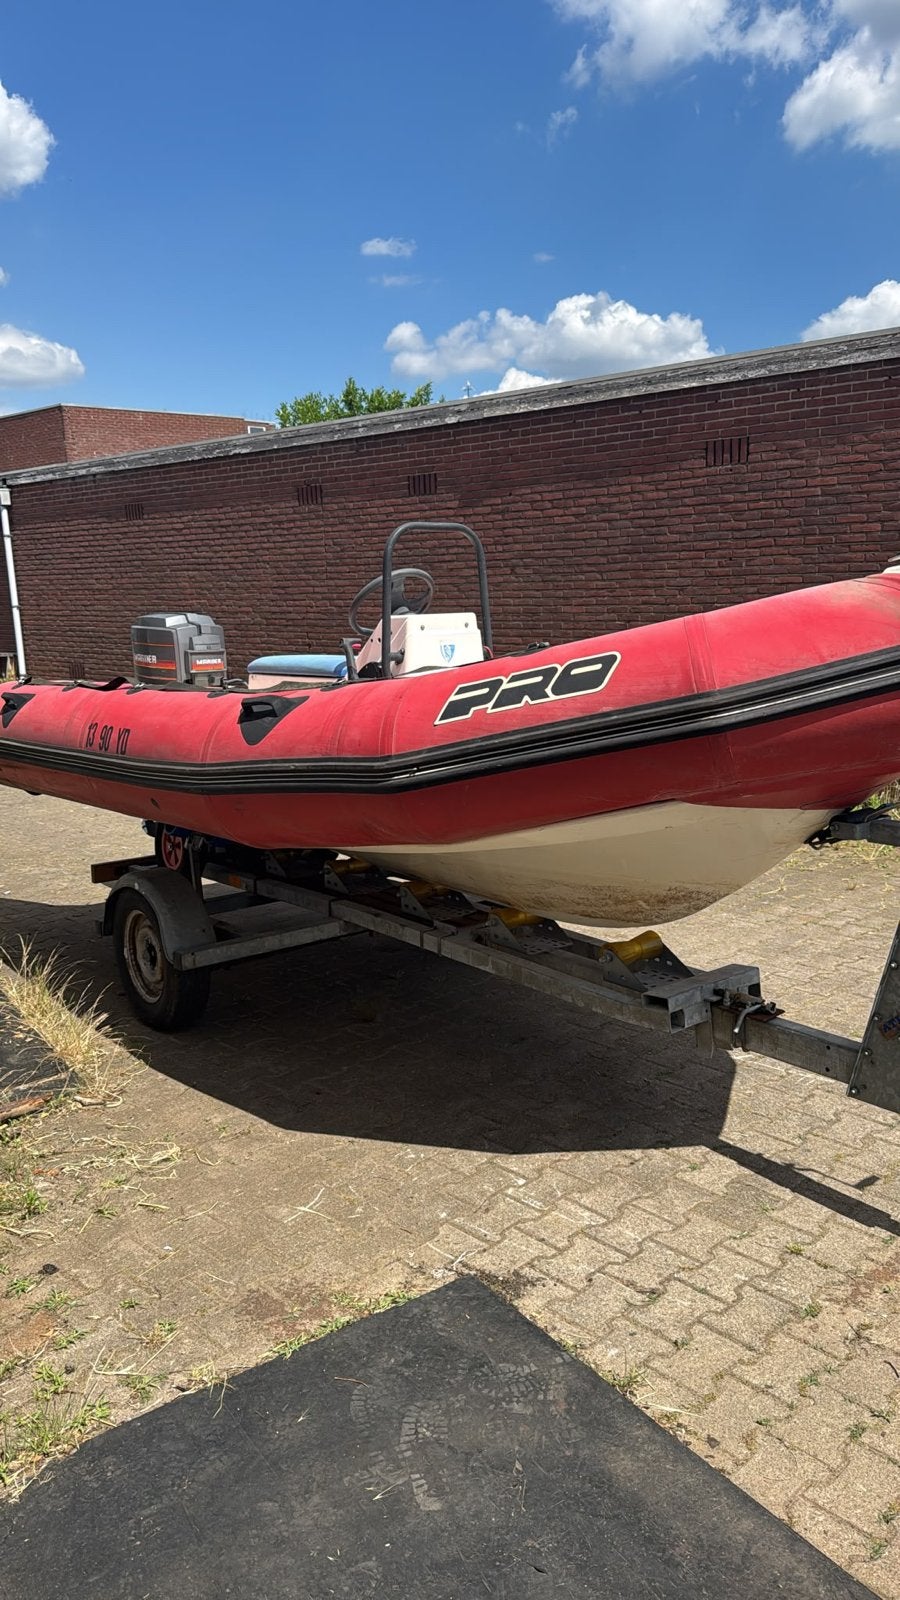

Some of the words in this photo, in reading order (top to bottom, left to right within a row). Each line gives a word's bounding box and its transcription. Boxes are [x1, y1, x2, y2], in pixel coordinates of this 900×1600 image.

[433, 651, 622, 726] PRO
[86, 722, 98, 748] 13
[99, 725, 114, 751] 90
